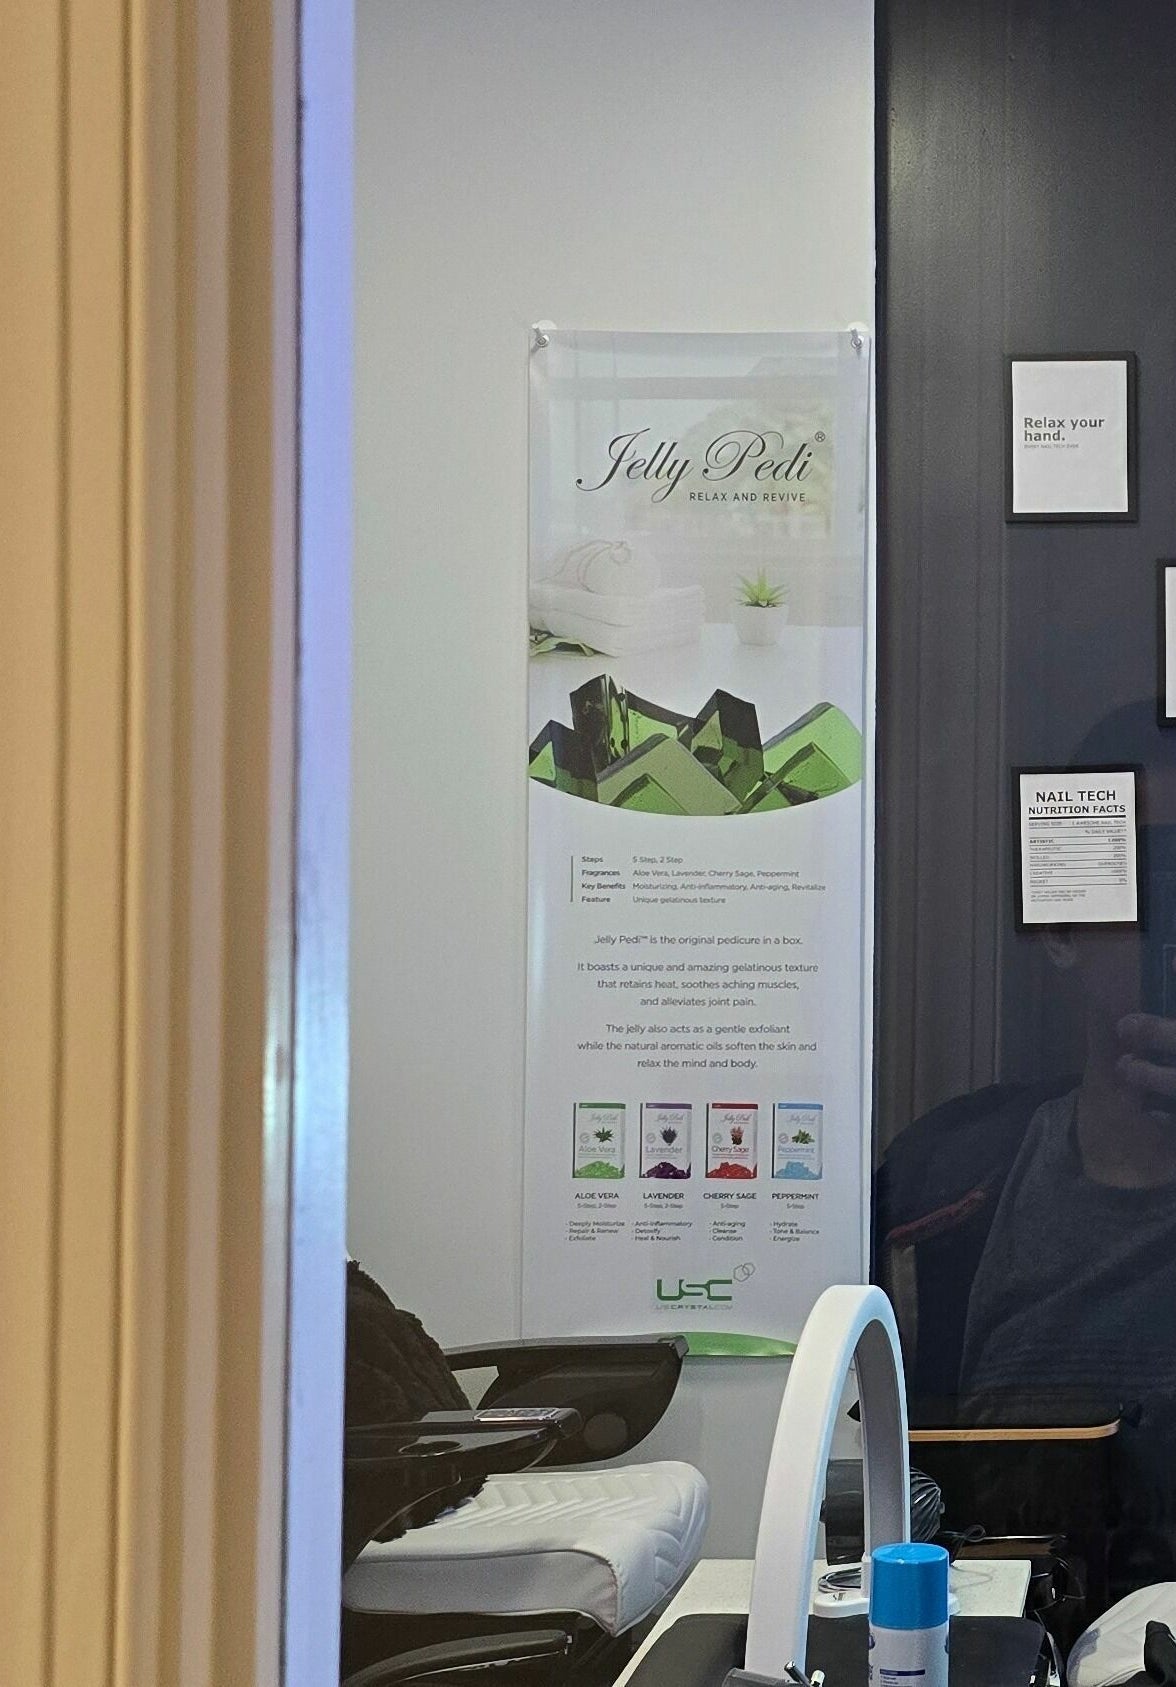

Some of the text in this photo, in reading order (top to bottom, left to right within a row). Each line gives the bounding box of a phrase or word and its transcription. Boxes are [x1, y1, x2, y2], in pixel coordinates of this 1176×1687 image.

[1024, 417, 1105, 430] Relax your
[1024, 430, 1065, 442] hand.
[575, 427, 693, 503] Jelly
[689, 492, 806, 502] RELAX AND REVIVE
[1036, 790, 1116, 803] NAIL TECH
[1028, 805, 1126, 815] NUTRITION FACTS
[581, 856, 604, 864] Steps
[581, 869, 621, 877] Fragrances
[708, 870, 733, 879] Cherry
[757, 870, 800, 878] Peppermint
[581, 882, 626, 891] Key Benefits
[632, 896, 659, 904] Unique
[594, 935, 617, 946] Jelly
[649, 935, 658, 944] is
[660, 935, 676, 945] the
[678, 935, 715, 946] original
[717, 936, 761, 946] pedicure
[763, 936, 772, 945] in
[773, 937, 780, 945] a
[782, 936, 803, 945] box.
[577, 962, 819, 974] It boasts a unique and amazing gelatinous texture
[597, 979, 617, 989] that
[619, 980, 653, 989] retains
[681, 980, 720, 989] soothes
[722, 980, 755, 990] aching
[757, 980, 800, 991] muscles,
[640, 997, 757, 1008] and alleviates joint pain.
[605, 1024, 625, 1033] The
[625, 1024, 646, 1035] jelly
[647, 1024, 668, 1033] also
[669, 1025, 691, 1034] acts
[715, 1024, 746, 1035] gentle
[748, 1024, 790, 1034] exfoliant
[577, 1041, 817, 1051] while the natural aromatic oils soften the skin and
[637, 1059, 758, 1070] relax the mind and body.
[643, 1192, 684, 1200] LAVENDER
[703, 1192, 757, 1200] CHERRY SAGE
[656, 1279, 733, 1301] USC
